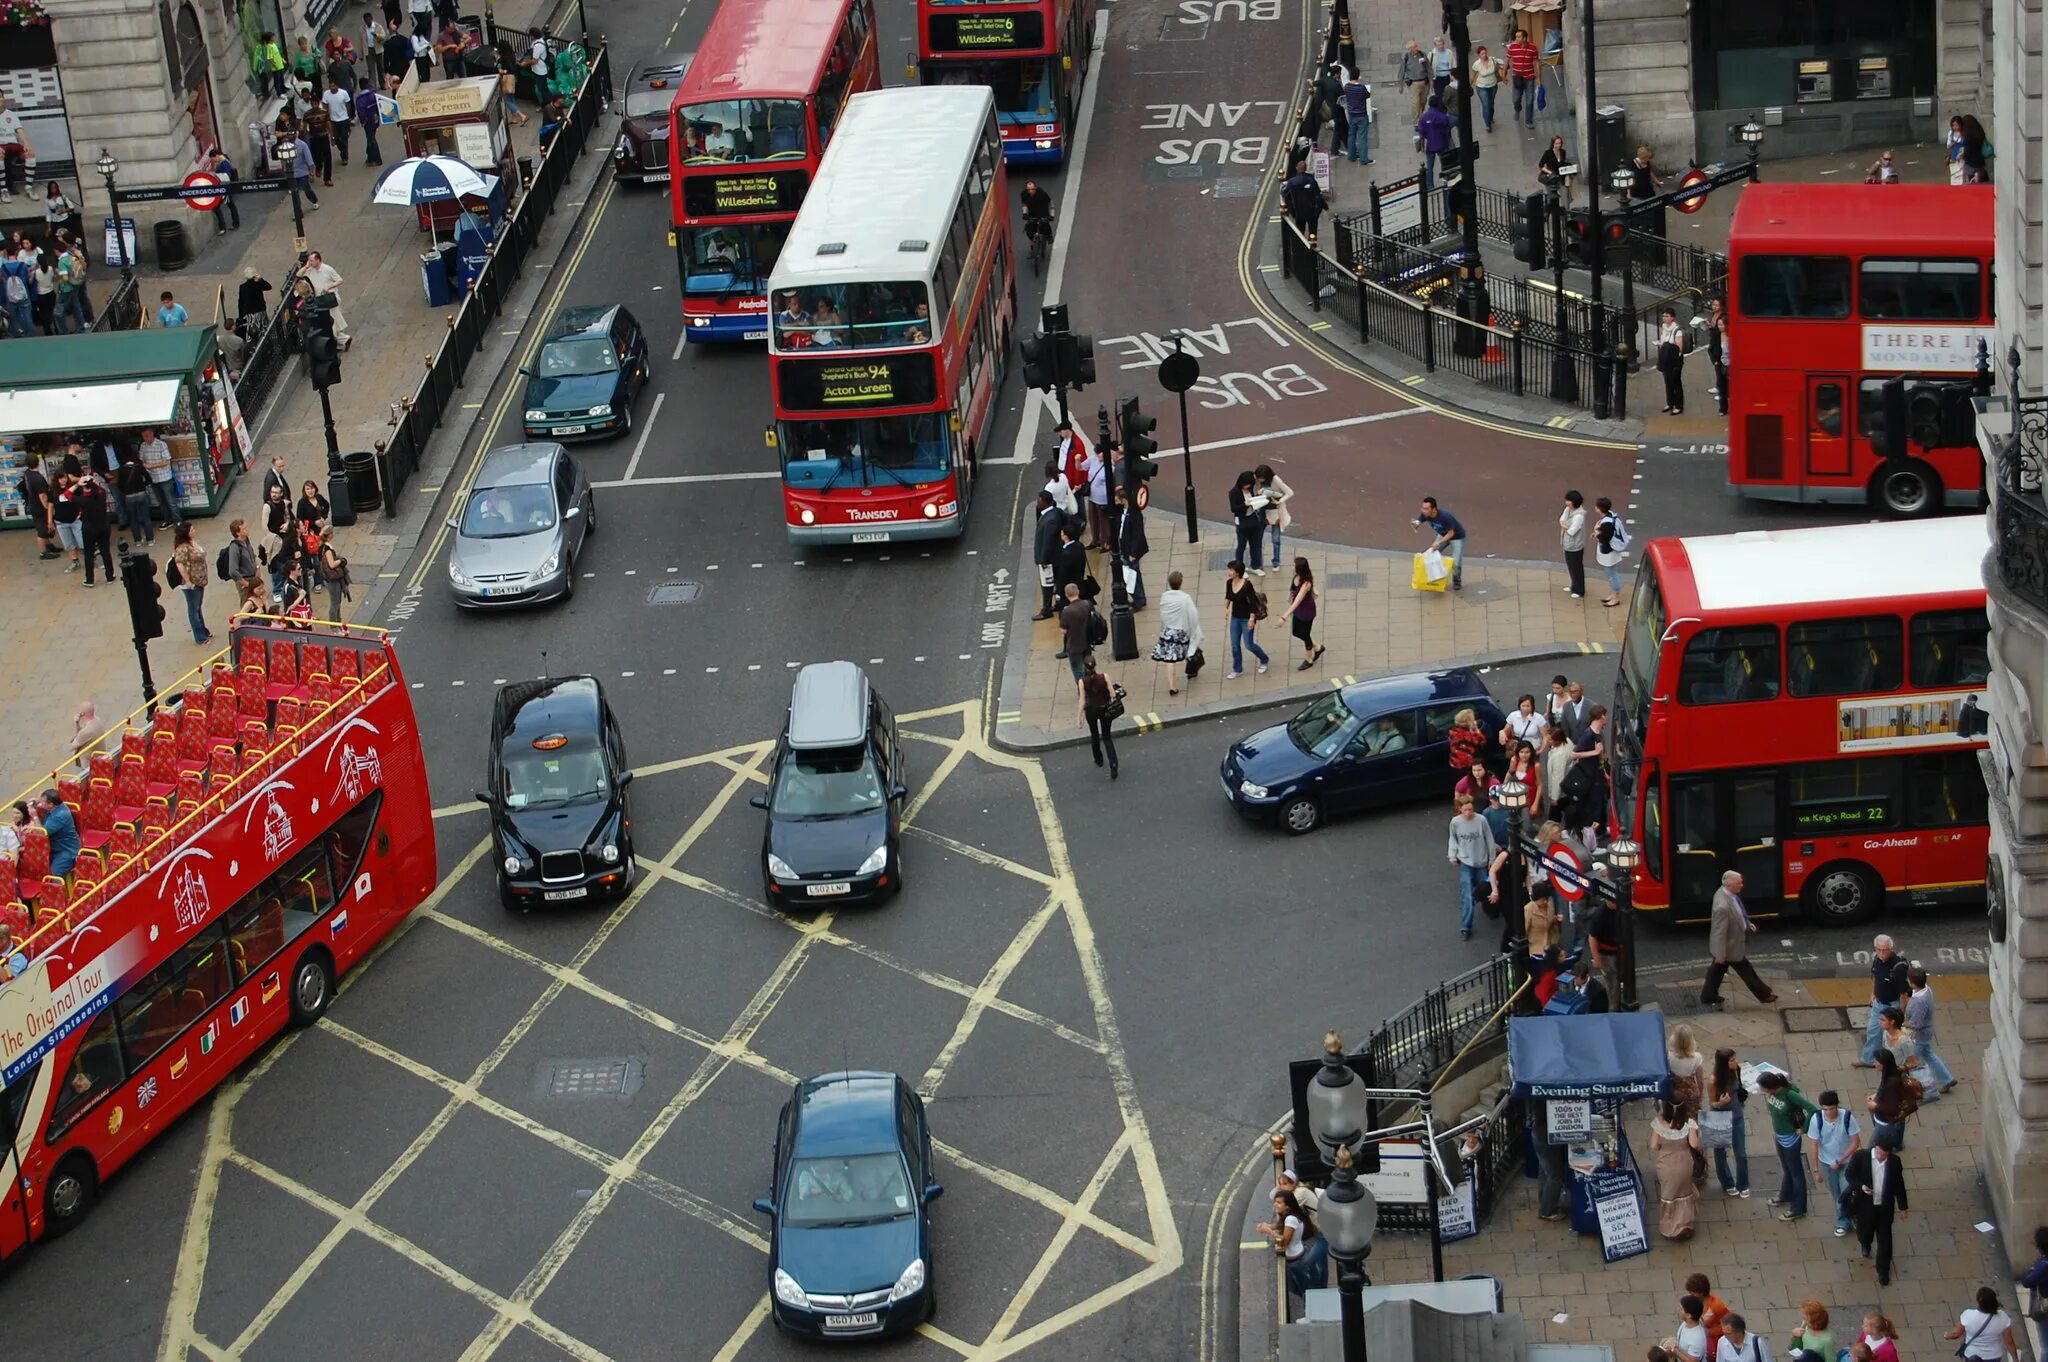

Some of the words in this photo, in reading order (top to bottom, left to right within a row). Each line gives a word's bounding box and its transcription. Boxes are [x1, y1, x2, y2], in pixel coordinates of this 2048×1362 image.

[1178, 0, 1282, 24] BUS
[1005, 17, 1013, 30] 6
[958, 34, 1001, 45] Willesden
[409, 105, 430, 116] Ice
[431, 101, 471, 113] Cream
[1139, 101, 1287, 129] LANE
[1154, 137, 1271, 165] BUS
[768, 176, 777, 191] 6
[178, 187, 227, 197] UNDERGROUND
[1673, 183, 1713, 201] UNDERGROUND
[716, 196, 764, 207] Willesden
[1870, 334, 1951, 348] THERE
[1869, 352, 1941, 363] MONDAY
[868, 364, 890, 379] 94
[824, 386, 856, 396] Acton
[858, 383, 892, 394] Green
[387, 594, 423, 622] LOOK
[980, 620, 1006, 648] LOOK
[1799, 815, 1811, 823] via
[1812, 812, 1838, 823] King's
[1840, 811, 1861, 820] Road
[1867, 808, 1884, 820] 22
[1863, 837, 1919, 850] Go-Ahead
[1541, 856, 1591, 889] UNDERGROUND
[1, 1028, 25, 1058] The
[26, 980, 77, 1038] Original
[76, 968, 104, 999] Tour
[7, 1045, 45, 1079] London
[48, 993, 109, 1046] Sightseeing
[1531, 1085, 1590, 1097] Evening
[1592, 1081, 1660, 1095] Standard
[1599, 1174, 1629, 1187] Evening
[1600, 1179, 1634, 1194] Standard
[1441, 1198, 1459, 1207] LIED
[1611, 1222, 1627, 1232] SEX
